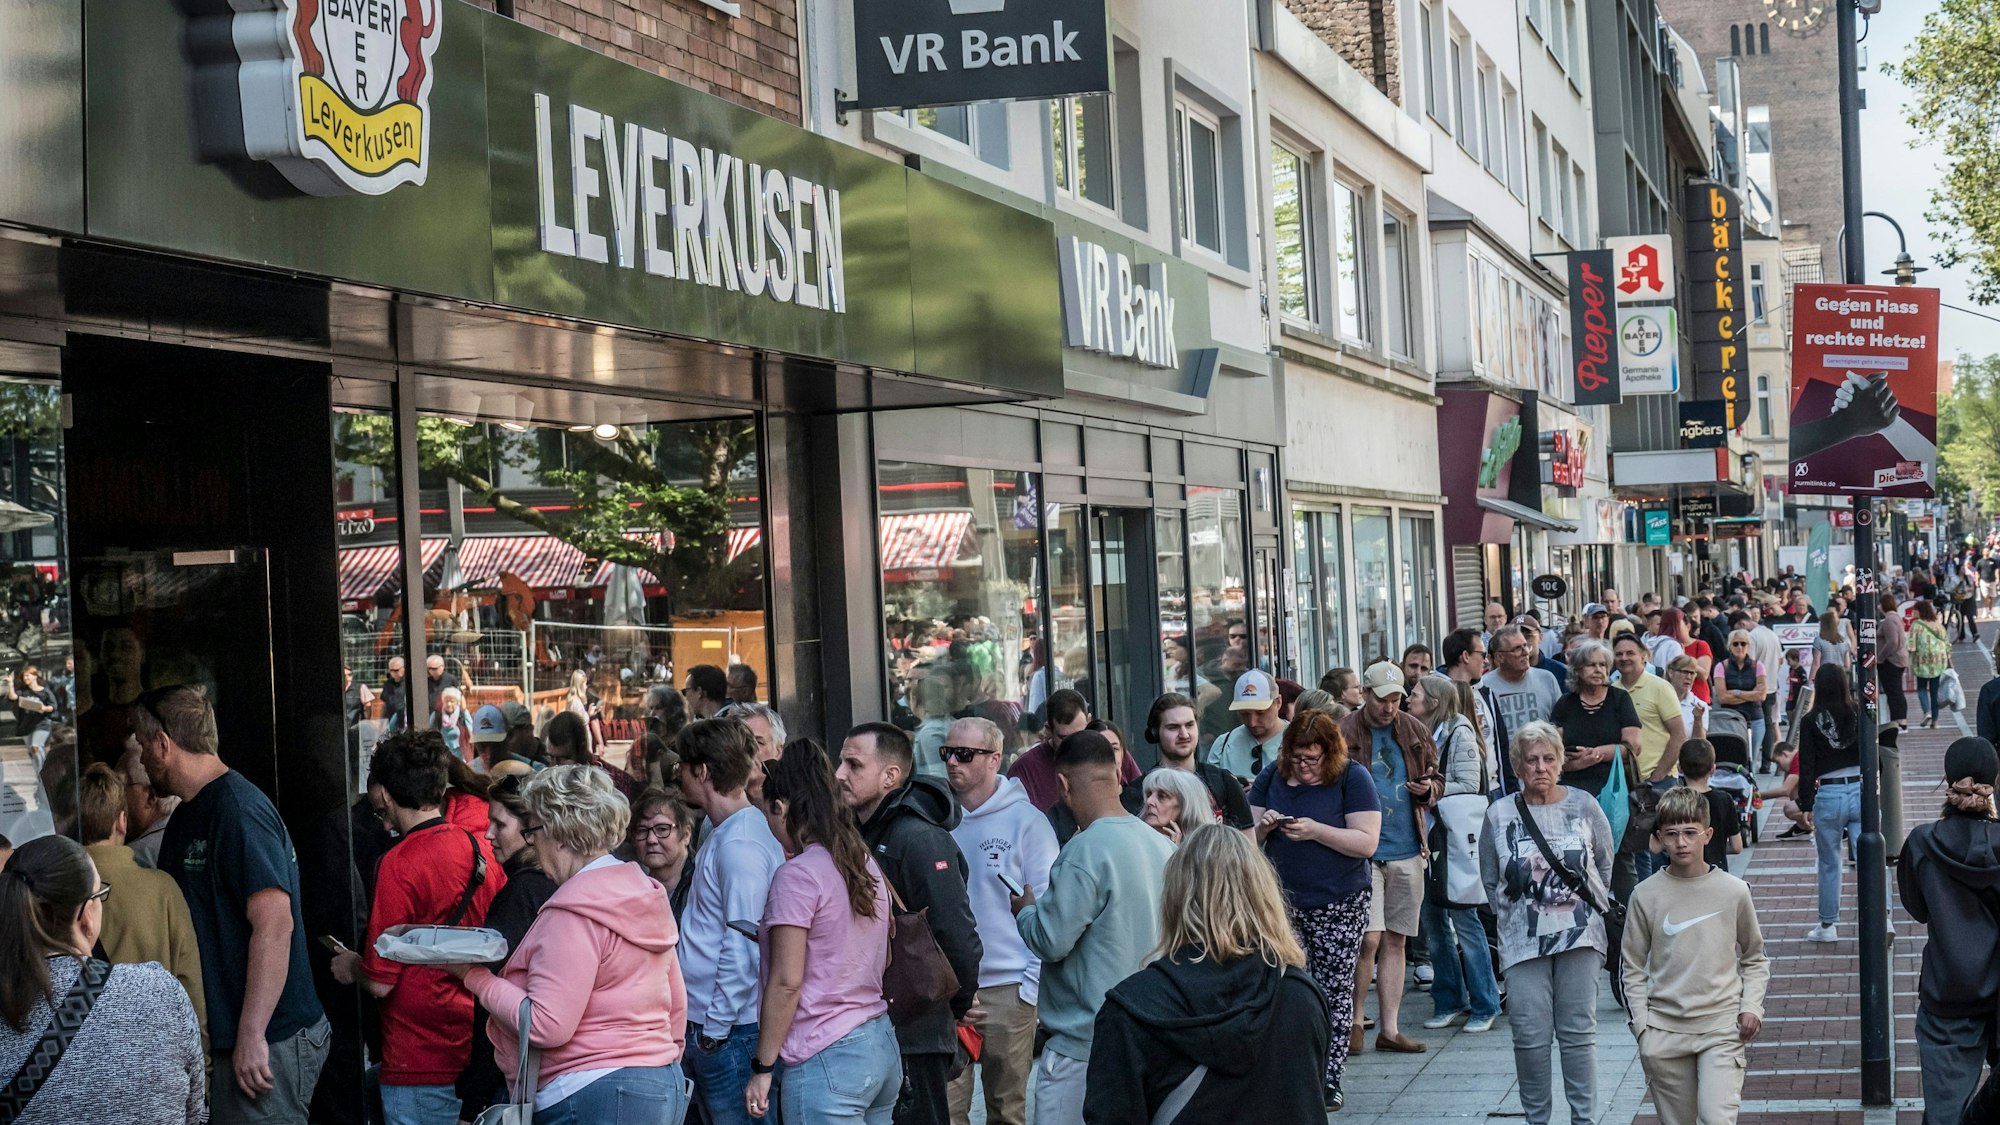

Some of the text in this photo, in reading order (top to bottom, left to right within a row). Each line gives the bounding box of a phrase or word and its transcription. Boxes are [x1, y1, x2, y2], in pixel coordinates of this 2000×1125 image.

[328, 0, 392, 35] BAYER
[879, 20, 1082, 75] VR Bank
[310, 86, 413, 162] Leverkusen
[534, 92, 846, 314] LEVERKUSEN
[1070, 235, 1179, 370] VR Bank
[1709, 187, 1736, 429] bäckerei
[1815, 297, 1919, 315] Gegen Hass
[1577, 262, 1613, 391] Pieper
[1850, 316, 1884, 330] und
[1624, 332, 1659, 340] BAYER
[1638, 319, 1646, 353] BAYER
[1805, 331, 1926, 349] rechte Hetze!
[1622, 366, 1660, 374] Germania
[1625, 374, 1662, 382] Apotheke
[1680, 425, 1723, 438] ngbers
[1879, 473, 1895, 483] Die
[1500, 693, 1537, 713] NUR
[979, 838, 1011, 849] HILFIGER
